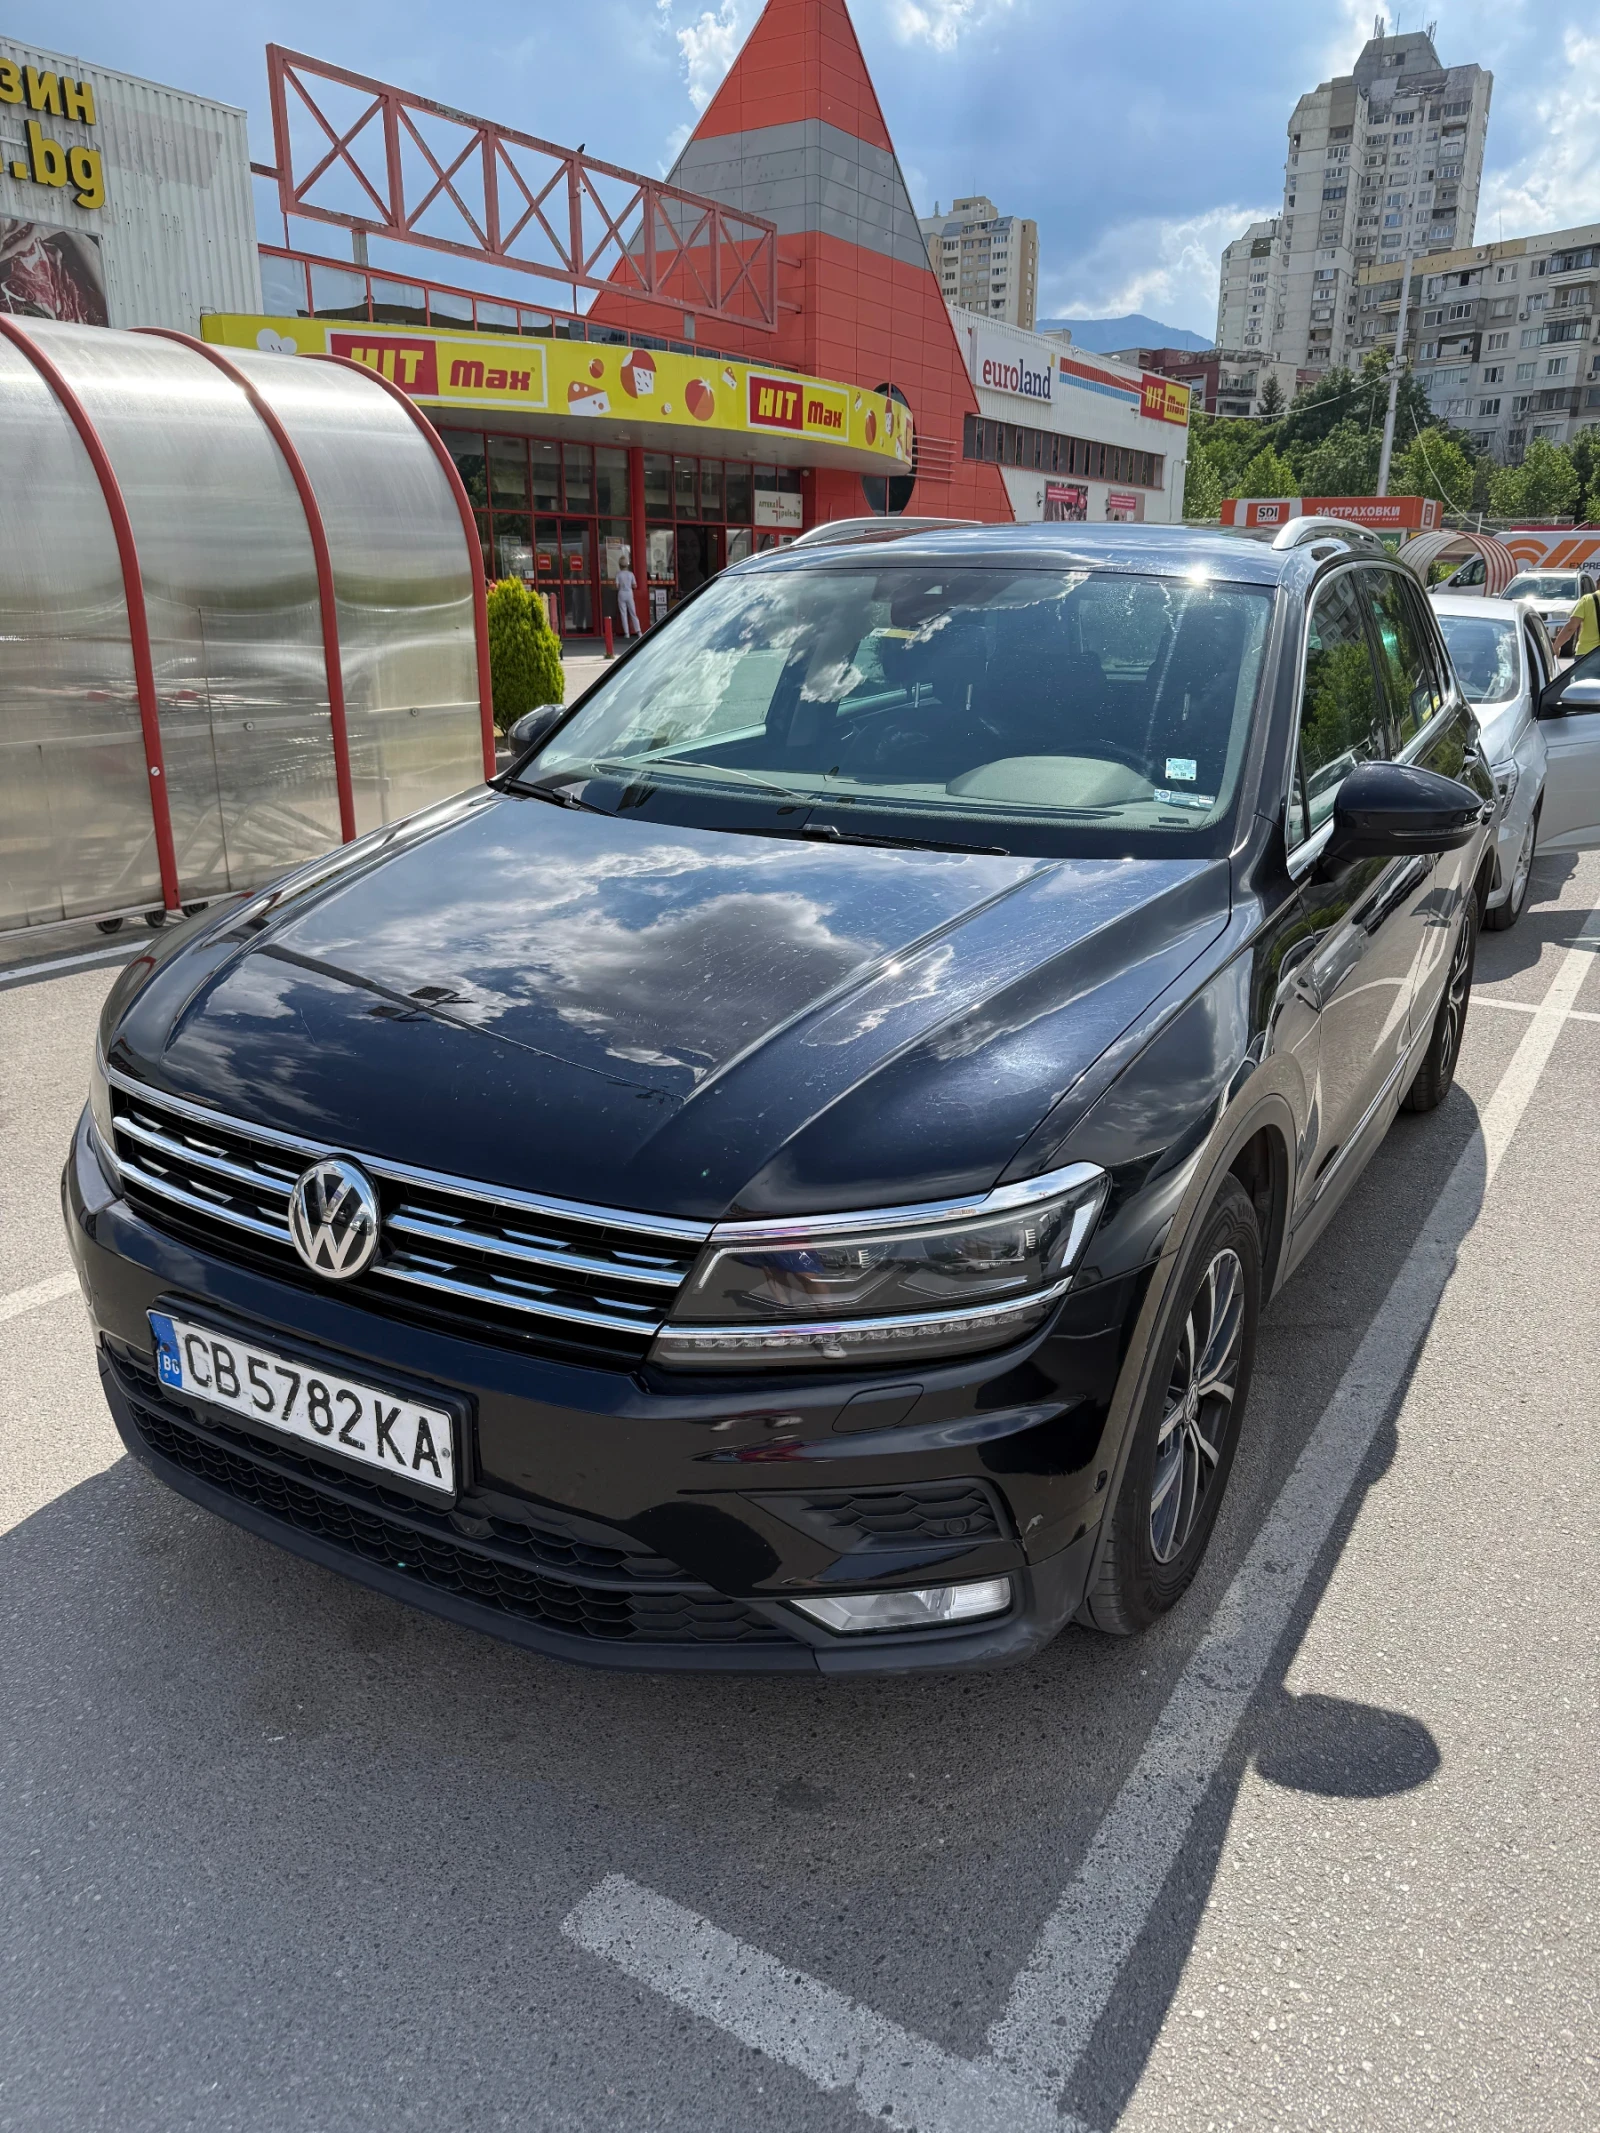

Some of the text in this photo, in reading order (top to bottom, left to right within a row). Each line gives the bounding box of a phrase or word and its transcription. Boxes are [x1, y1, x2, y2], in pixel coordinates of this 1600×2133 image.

[0, 119, 106, 209] .bg
[982, 358, 1052, 400] euroland
[758, 387, 798, 420] HIT
[1145, 385, 1163, 410] HIT
[1258, 507, 1278, 518] SDI
[1315, 506, 1401, 517] ЗАСТРАХОВКИ
[163, 1354, 180, 1376] BG
